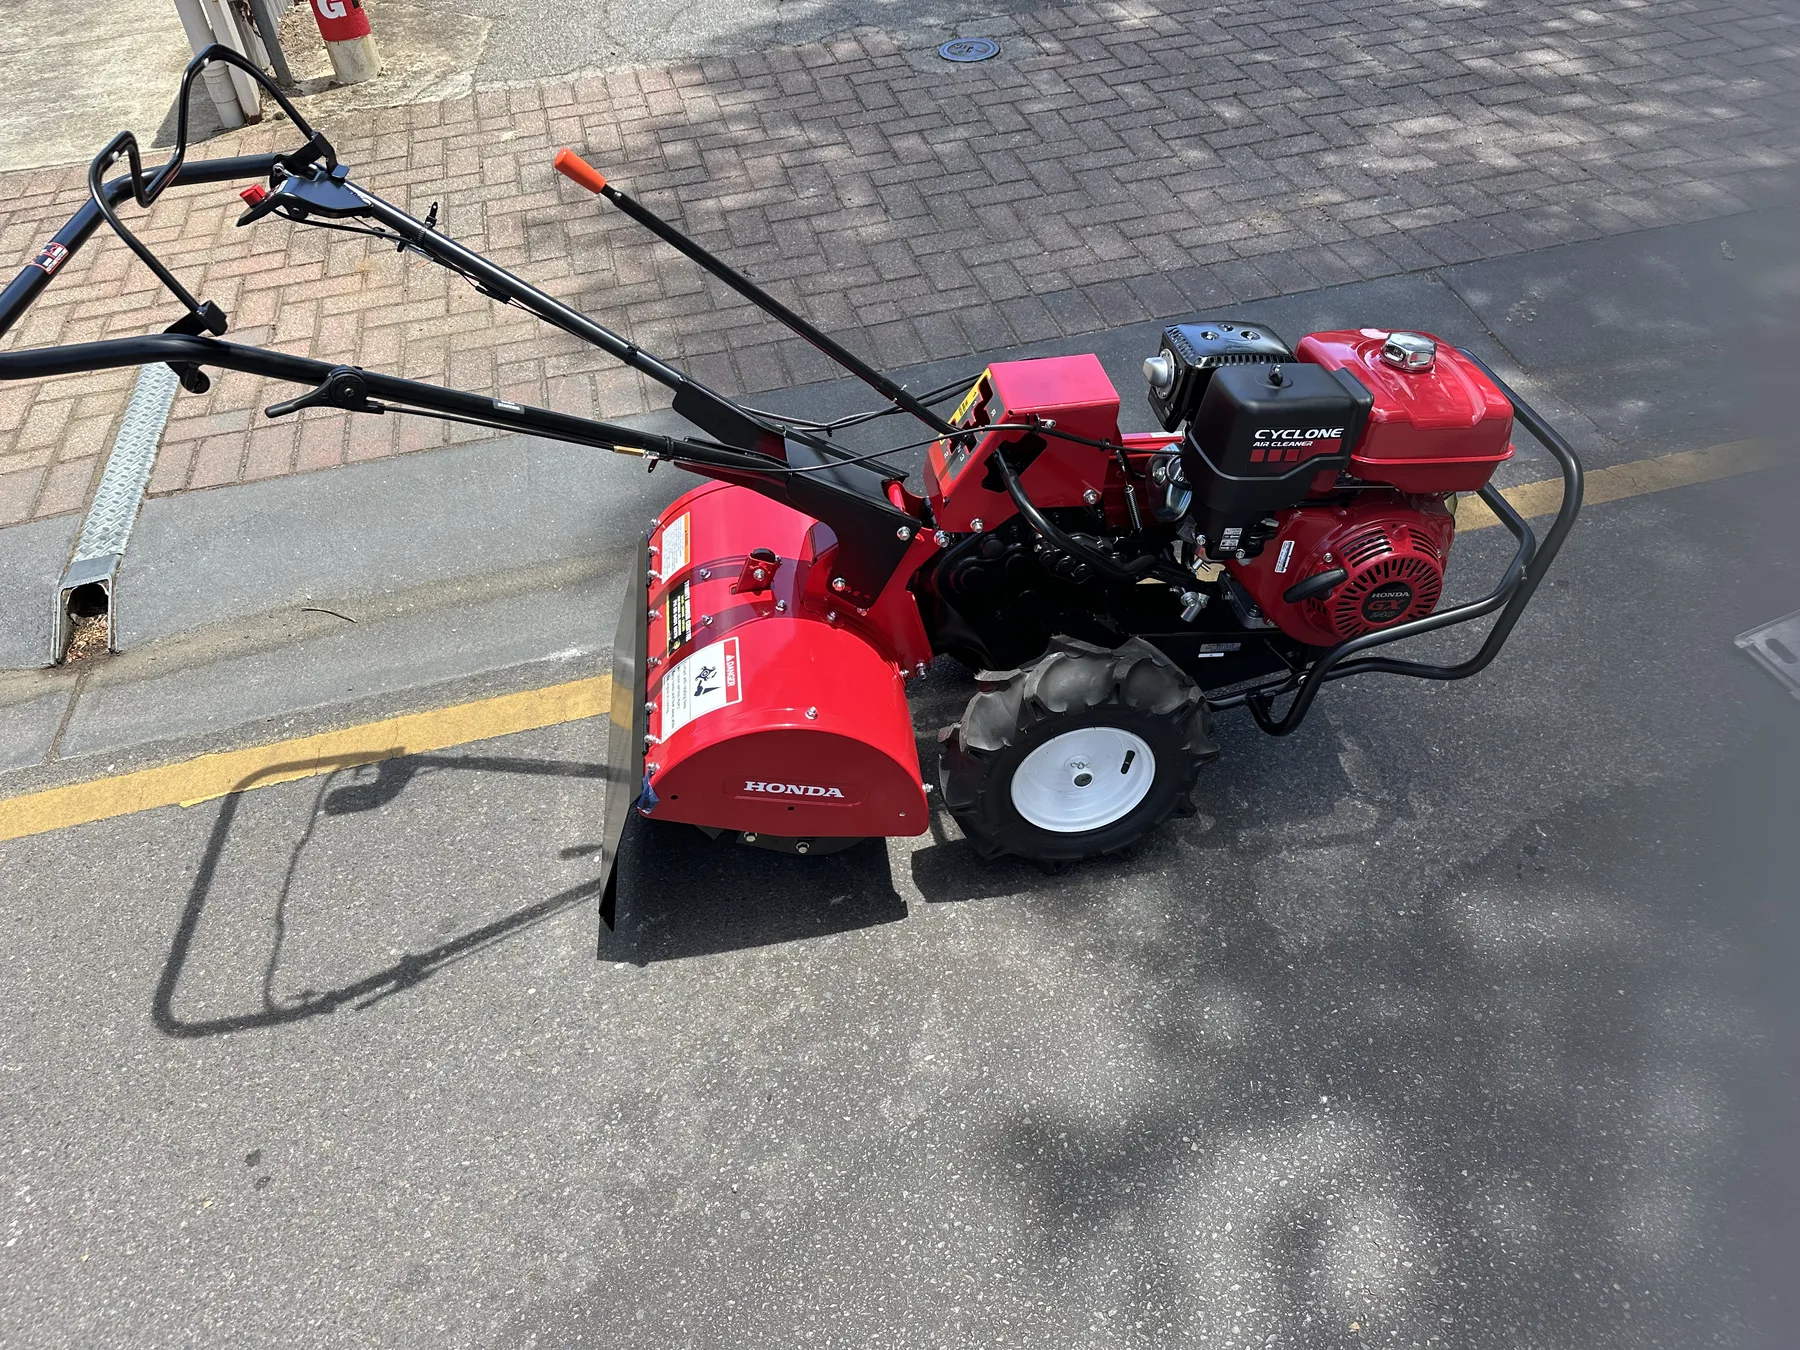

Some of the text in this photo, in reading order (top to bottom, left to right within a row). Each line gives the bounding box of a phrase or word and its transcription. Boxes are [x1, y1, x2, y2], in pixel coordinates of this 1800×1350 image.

[1254, 428, 1344, 439] CYCLONE
[726, 661, 736, 687] DANGER
[743, 781, 845, 798] HONDA
